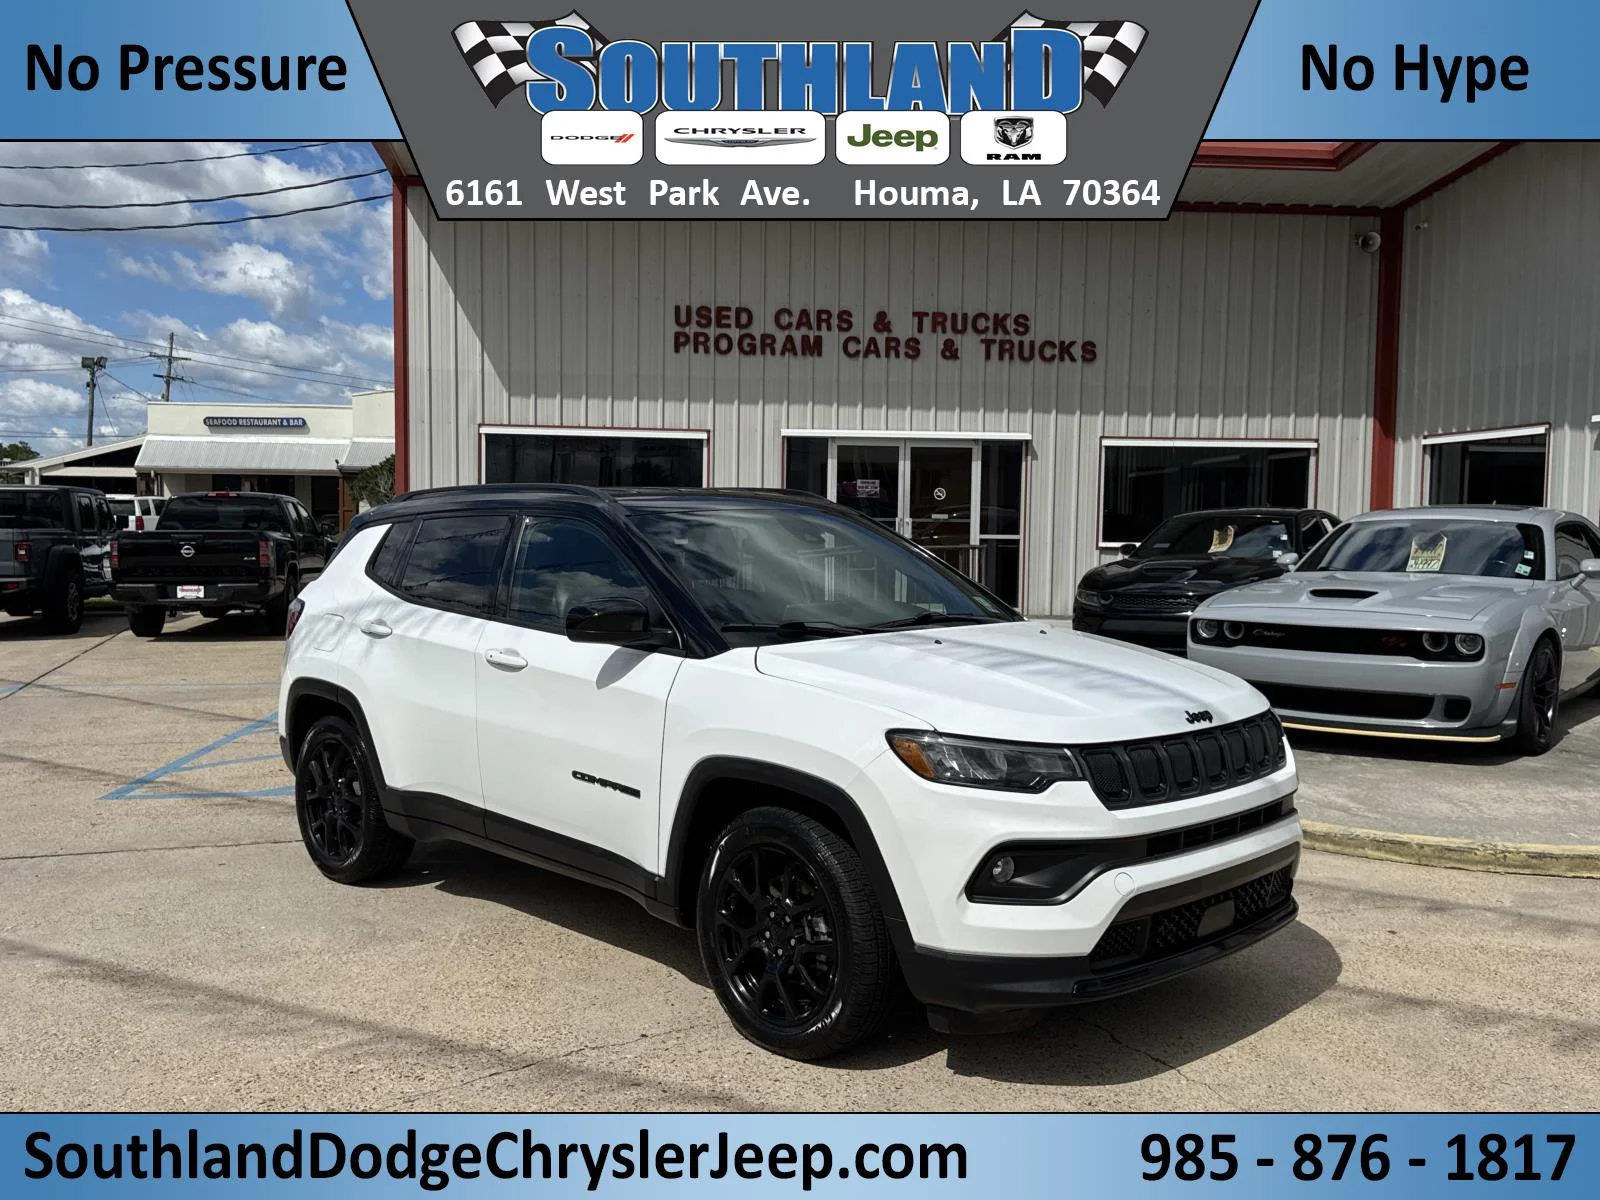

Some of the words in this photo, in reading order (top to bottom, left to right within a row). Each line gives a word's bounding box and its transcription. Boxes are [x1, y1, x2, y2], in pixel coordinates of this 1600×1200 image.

[674, 304, 754, 330] USED
[774, 307, 854, 333] CARS
[873, 310, 893, 334] &
[912, 311, 1031, 336] TRUCKS
[673, 331, 824, 358] PROGRAM
[842, 335, 922, 360] CARS
[940, 338, 960, 361] &
[980, 338, 1098, 363] TRUCKS
[205, 418, 238, 426] SEAFOOD
[239, 418, 281, 426] RESTAURANT
